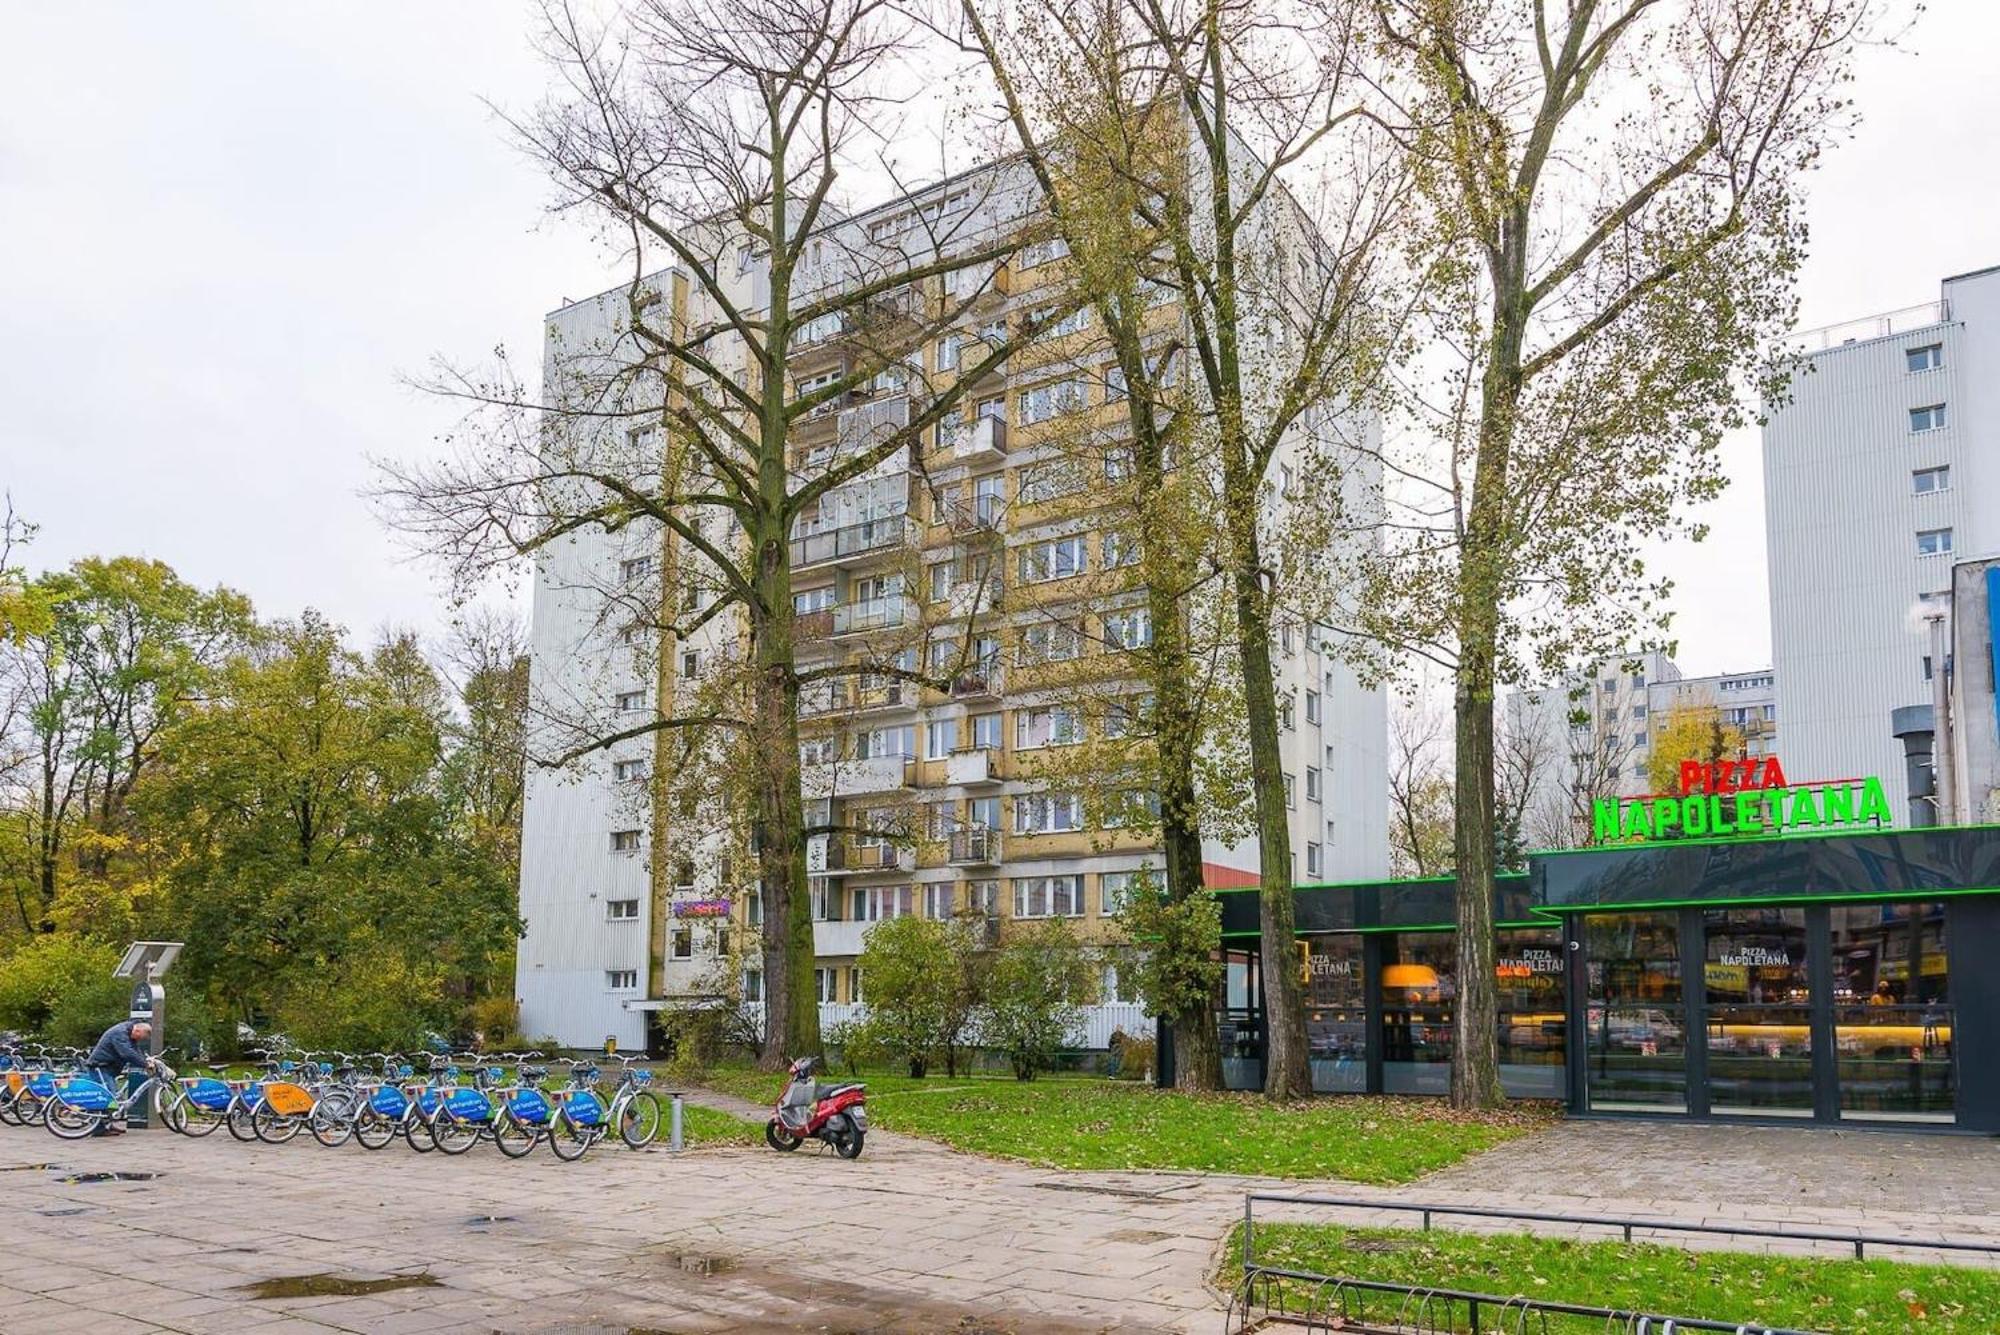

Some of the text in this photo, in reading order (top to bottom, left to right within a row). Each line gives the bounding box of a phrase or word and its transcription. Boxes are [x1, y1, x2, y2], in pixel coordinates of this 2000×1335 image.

[1680, 756, 1788, 795] PIZZA
[1592, 776, 1892, 841] NAPOLETANA
[1523, 949, 1552, 960] PIZZA
[1741, 947, 1767, 956] PIZZA
[1721, 954, 1790, 966] NAPOLETANA
[1299, 960, 1352, 975] POLETANA
